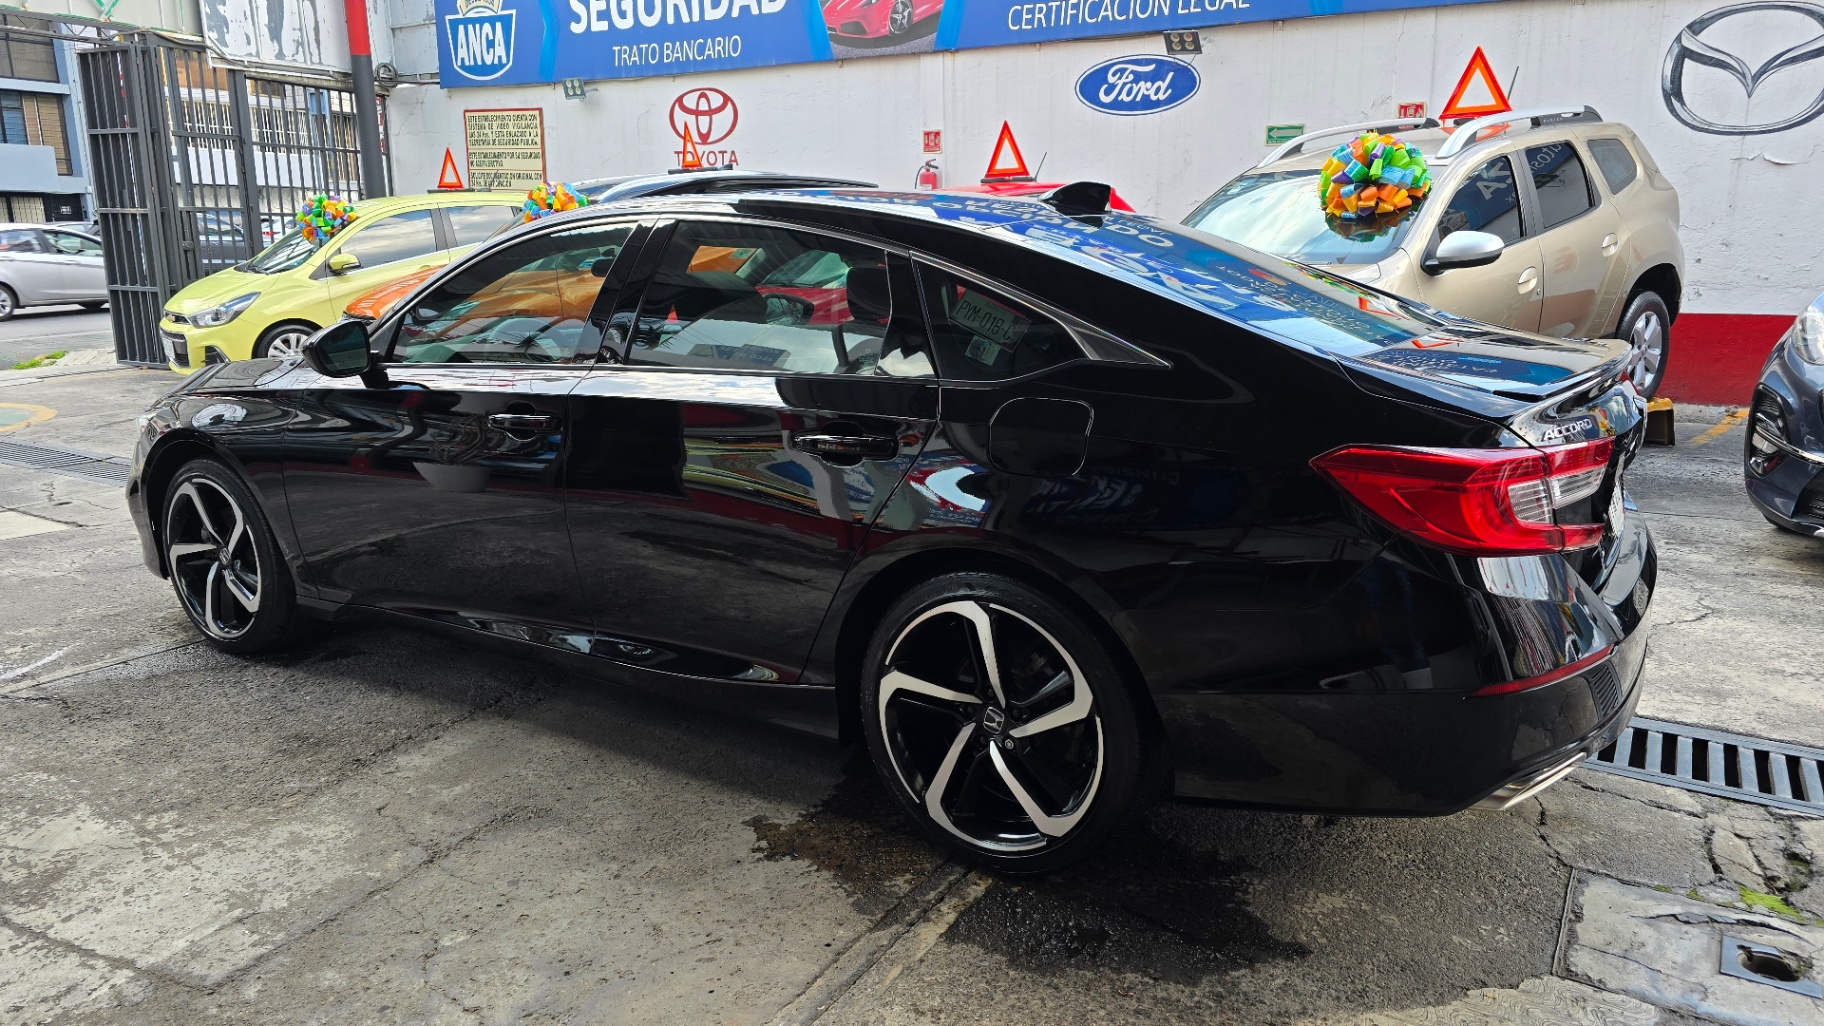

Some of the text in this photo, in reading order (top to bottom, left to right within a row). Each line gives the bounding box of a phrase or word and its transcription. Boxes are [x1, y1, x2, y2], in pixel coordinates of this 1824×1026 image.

[1008, 0, 1250, 30] CERTIFICACION LEG
[457, 21, 507, 66] ANCA
[612, 34, 742, 67] TRATO BANCARIO
[1099, 63, 1174, 103] Ford
[956, 300, 1016, 341] PYM-018-C
[1543, 418, 1593, 441] ACCORD
